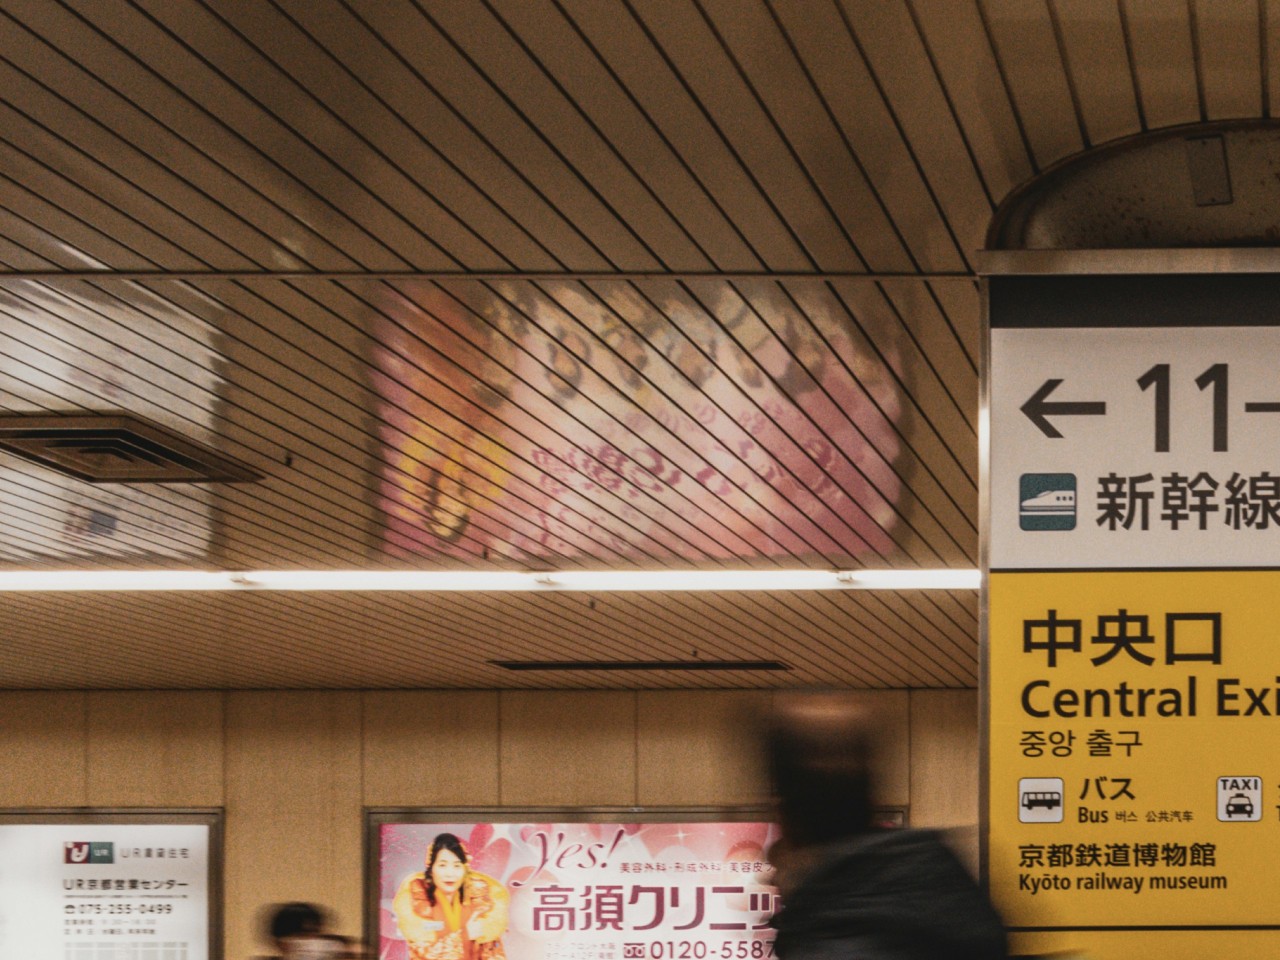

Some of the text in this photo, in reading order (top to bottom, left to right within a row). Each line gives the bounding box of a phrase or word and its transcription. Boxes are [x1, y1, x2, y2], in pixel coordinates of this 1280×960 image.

[1023, 608, 1222, 668] 中央口
[1021, 675, 1197, 719] Central
[1019, 729, 1143, 758] 중앙 출구
[1079, 776, 1136, 801] バス
[1220, 778, 1259, 791] TAXI
[1078, 806, 1109, 824] Bus
[1115, 810, 1138, 823] 버스
[1145, 810, 1193, 823] 公共汽车
[1018, 842, 1216, 869] 京都鉄道博物館
[1018, 871, 1228, 896] Kyōto railway museum
